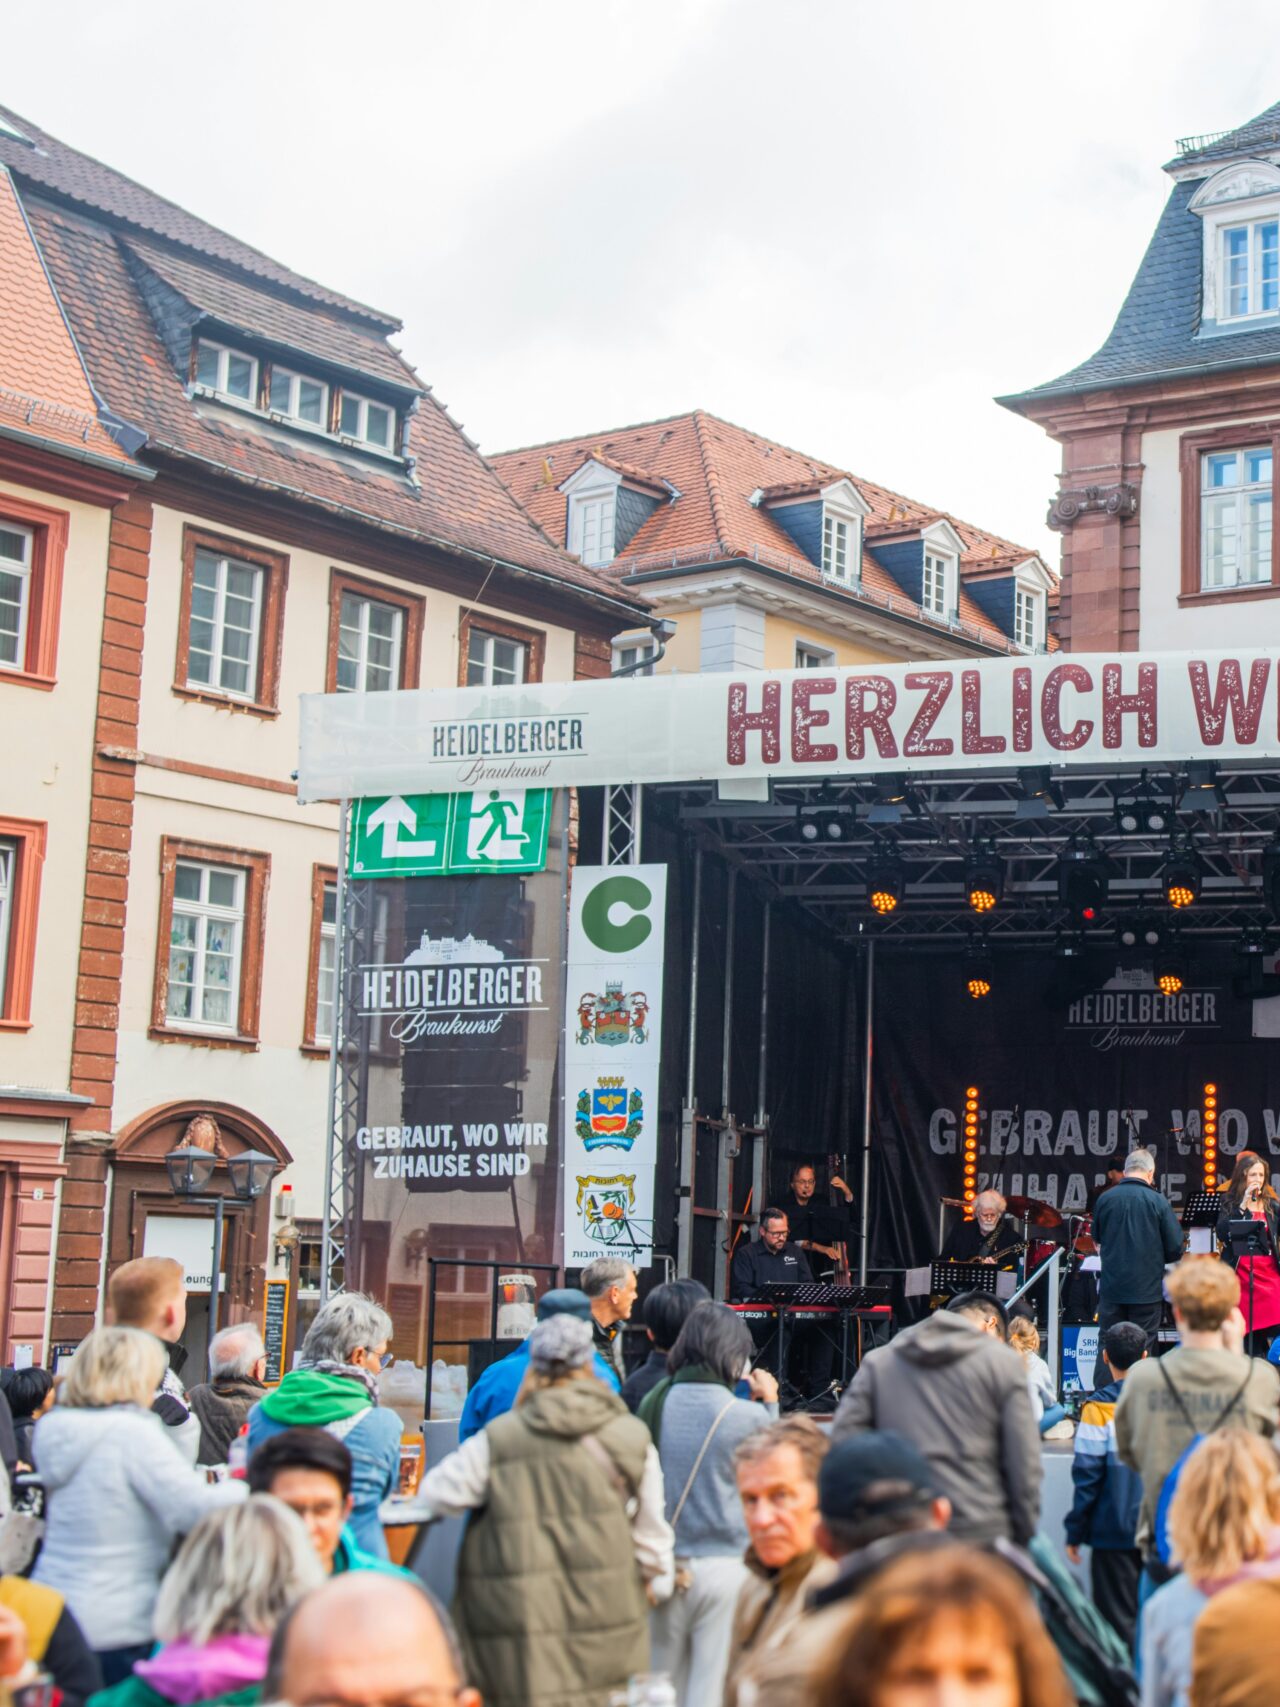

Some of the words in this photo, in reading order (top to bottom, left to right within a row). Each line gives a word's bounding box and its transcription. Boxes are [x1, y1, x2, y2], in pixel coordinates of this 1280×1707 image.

[726, 661, 1158, 766] HERZLICH
[433, 719, 583, 758] HEIDELBERGER
[457, 757, 553, 786] Braukunst
[363, 965, 543, 1009] HEIDELBERGER
[1068, 992, 1217, 1024] HEIDELBERGER
[389, 1007, 504, 1043] Braukunst
[1090, 1025, 1186, 1051] Braukunst
[356, 1124, 458, 1150] GEBRAUT,
[462, 1123, 499, 1147] WO
[504, 1122, 548, 1146] WIR
[373, 1153, 471, 1179] ZUHAUSE
[476, 1153, 531, 1177] SIND
[185, 1276, 212, 1286] oung
[1063, 1348, 1077, 1359] Big
[1078, 1348, 1098, 1356] Band
[1082, 1338, 1098, 1347] SRH
